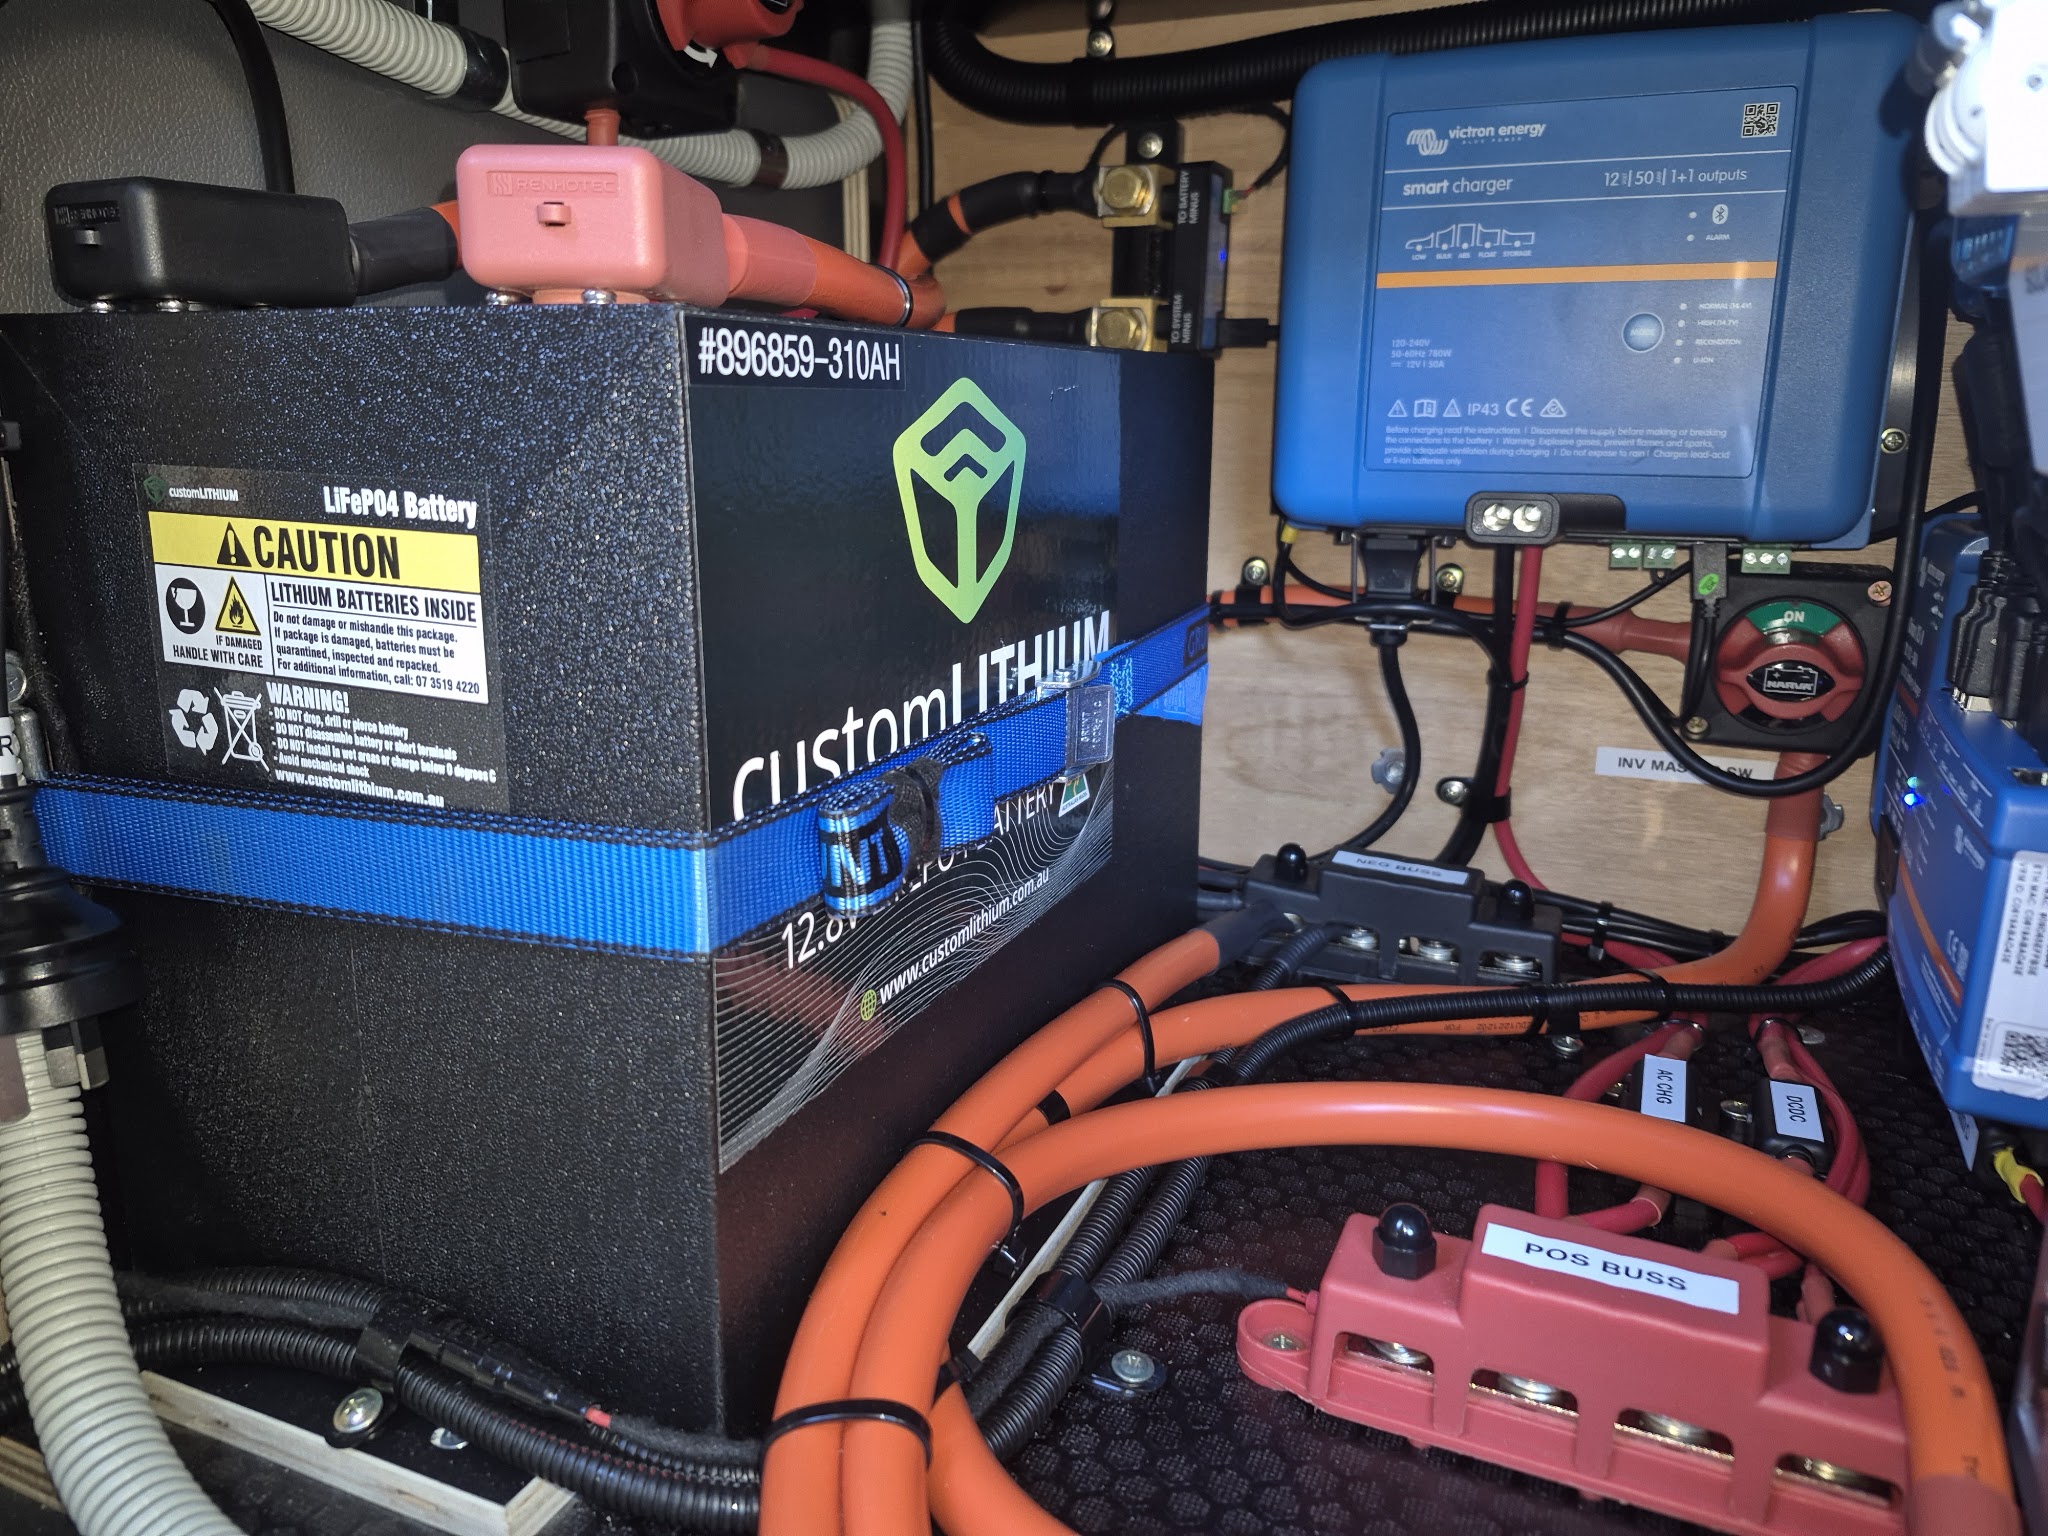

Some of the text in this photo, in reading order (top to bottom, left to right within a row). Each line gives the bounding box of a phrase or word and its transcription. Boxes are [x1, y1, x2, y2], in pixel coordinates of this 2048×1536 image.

[1449, 123, 1547, 139] victron energy
[518, 179, 617, 194] RENHOTEC
[1402, 177, 1514, 196] smart charger
[1604, 171, 1620, 187] 12
[1634, 170, 1654, 185] 50
[1671, 168, 1695, 184] 1+1
[1698, 169, 1748, 184] outputs
[1177, 170, 1190, 225] TO BATTERY
[1188, 191, 1200, 224] MINUS
[1170, 294, 1183, 344] TO SYSTEM
[1182, 312, 1192, 344] MINUS
[698, 325, 901, 381] #896859-310AH
[1391, 339, 1431, 348] 120-240V
[1467, 402, 1500, 416] IP43
[1617, 427, 1645, 436] before
[1646, 428, 1677, 437] making
[1689, 428, 1727, 438] breaking
[169, 486, 239, 502] customLITHIUM
[404, 491, 478, 529] Battery
[253, 525, 401, 580] CAUTION
[271, 581, 477, 623] LITHIUM BATTERIES INSIDE
[1783, 610, 1805, 622] ON
[215, 634, 263, 650] IF DAMAGED
[273, 611, 458, 644] Do not damage or mishandle this package.
[274, 626, 455, 658] If package is damaged, batteries must be
[173, 644, 264, 668] HANDLE WITH CARE
[276, 644, 441, 674] quarantined, inspected and repacked.
[277, 657, 480, 694] For additional information, call: 07 3519 4220
[1766, 680, 1814, 691] NARVA
[265, 681, 350, 714] WARNING!
[274, 706, 409, 741] DO NOT drop, drill or pierce battery
[733, 610, 1110, 822] customLITHIUM
[275, 721, 458, 762] DO NOT disassemble battery or short terminals
[277, 736, 289, 750] DO
[289, 738, 306, 753] NOT
[306, 741, 331, 757] install
[332, 745, 341, 759] in
[342, 748, 357, 761] wet
[357, 751, 381, 765] areas
[381, 755, 390, 767] or
[391, 755, 420, 773] charge
[420, 759, 446, 776] below
[454, 764, 489, 782] degrees
[489, 768, 497, 784] C
[279, 752, 370, 778] Avoid mechanical shock
[1617, 757, 1646, 769] INV
[274, 769, 445, 808] www.customlithium.com.au
[994, 781, 1055, 836] ATTERY
[1356, 857, 1443, 878] NEG BUSS
[879, 866, 1050, 1004] www.customlithium.com.au
[1656, 1068, 1674, 1105] AC CHG
[1786, 1095, 1807, 1123] DCDC
[1525, 1242, 1687, 1291] POS BUSS
